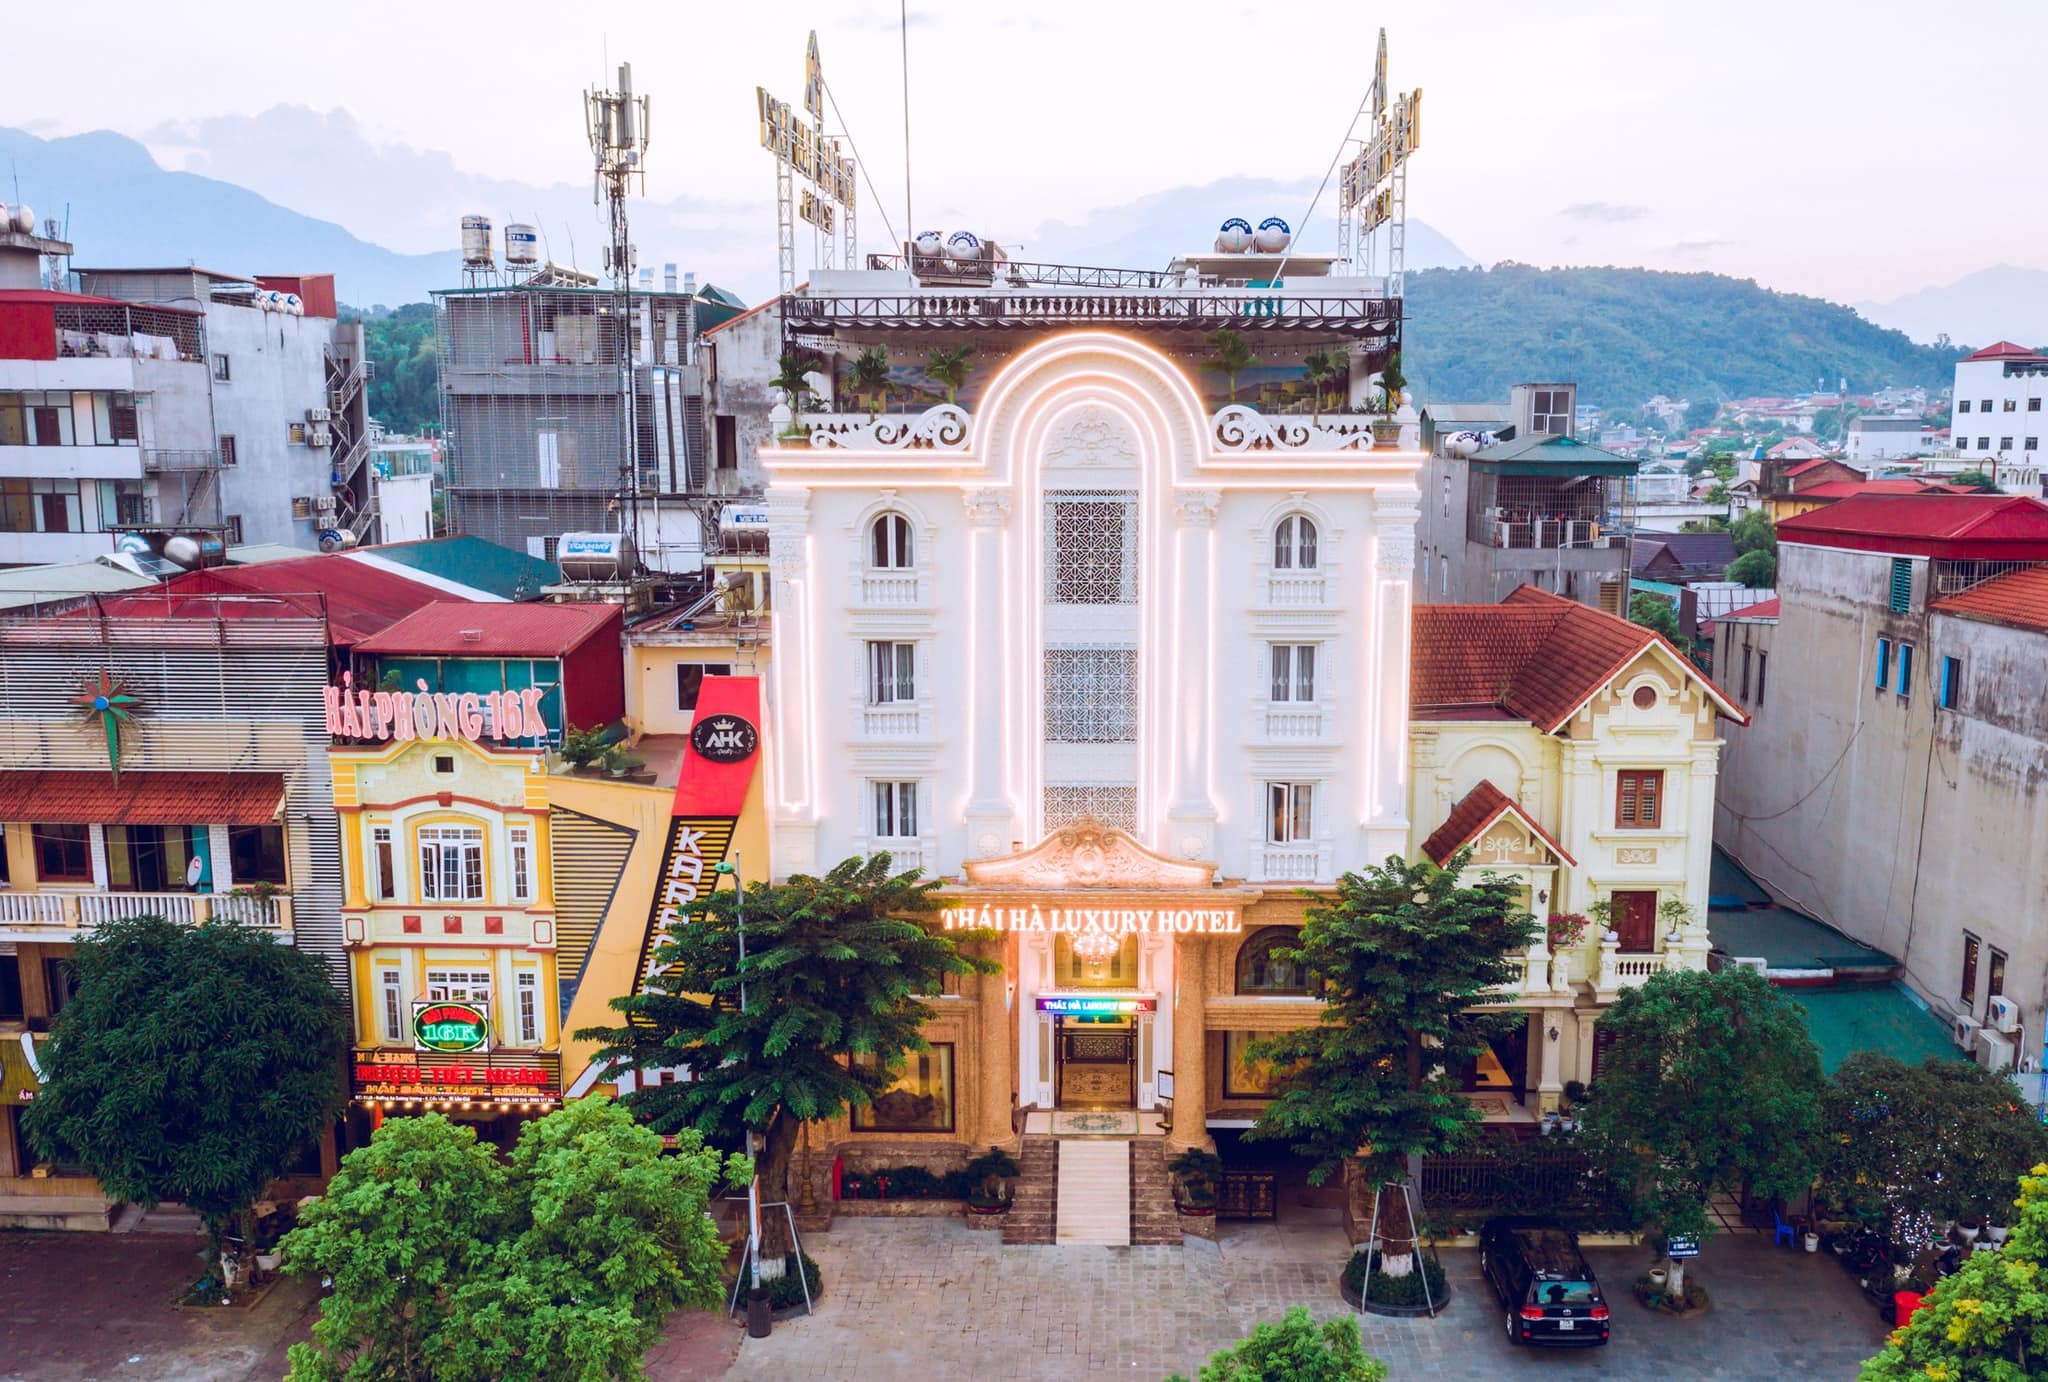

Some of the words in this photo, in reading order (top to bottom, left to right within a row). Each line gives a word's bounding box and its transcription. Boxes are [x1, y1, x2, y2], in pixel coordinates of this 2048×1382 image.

[323, 671, 374, 739] HẢI
[374, 678, 483, 741] PHÒNG
[487, 688, 548, 740] 16K
[705, 731, 744, 748] AHK
[940, 904, 1004, 932] THÁI
[1009, 904, 1046, 932] HÀ
[1051, 909, 1151, 933] LUXURY
[1157, 910, 1242, 933] HOTEL
[422, 1024, 480, 1041] 16K
